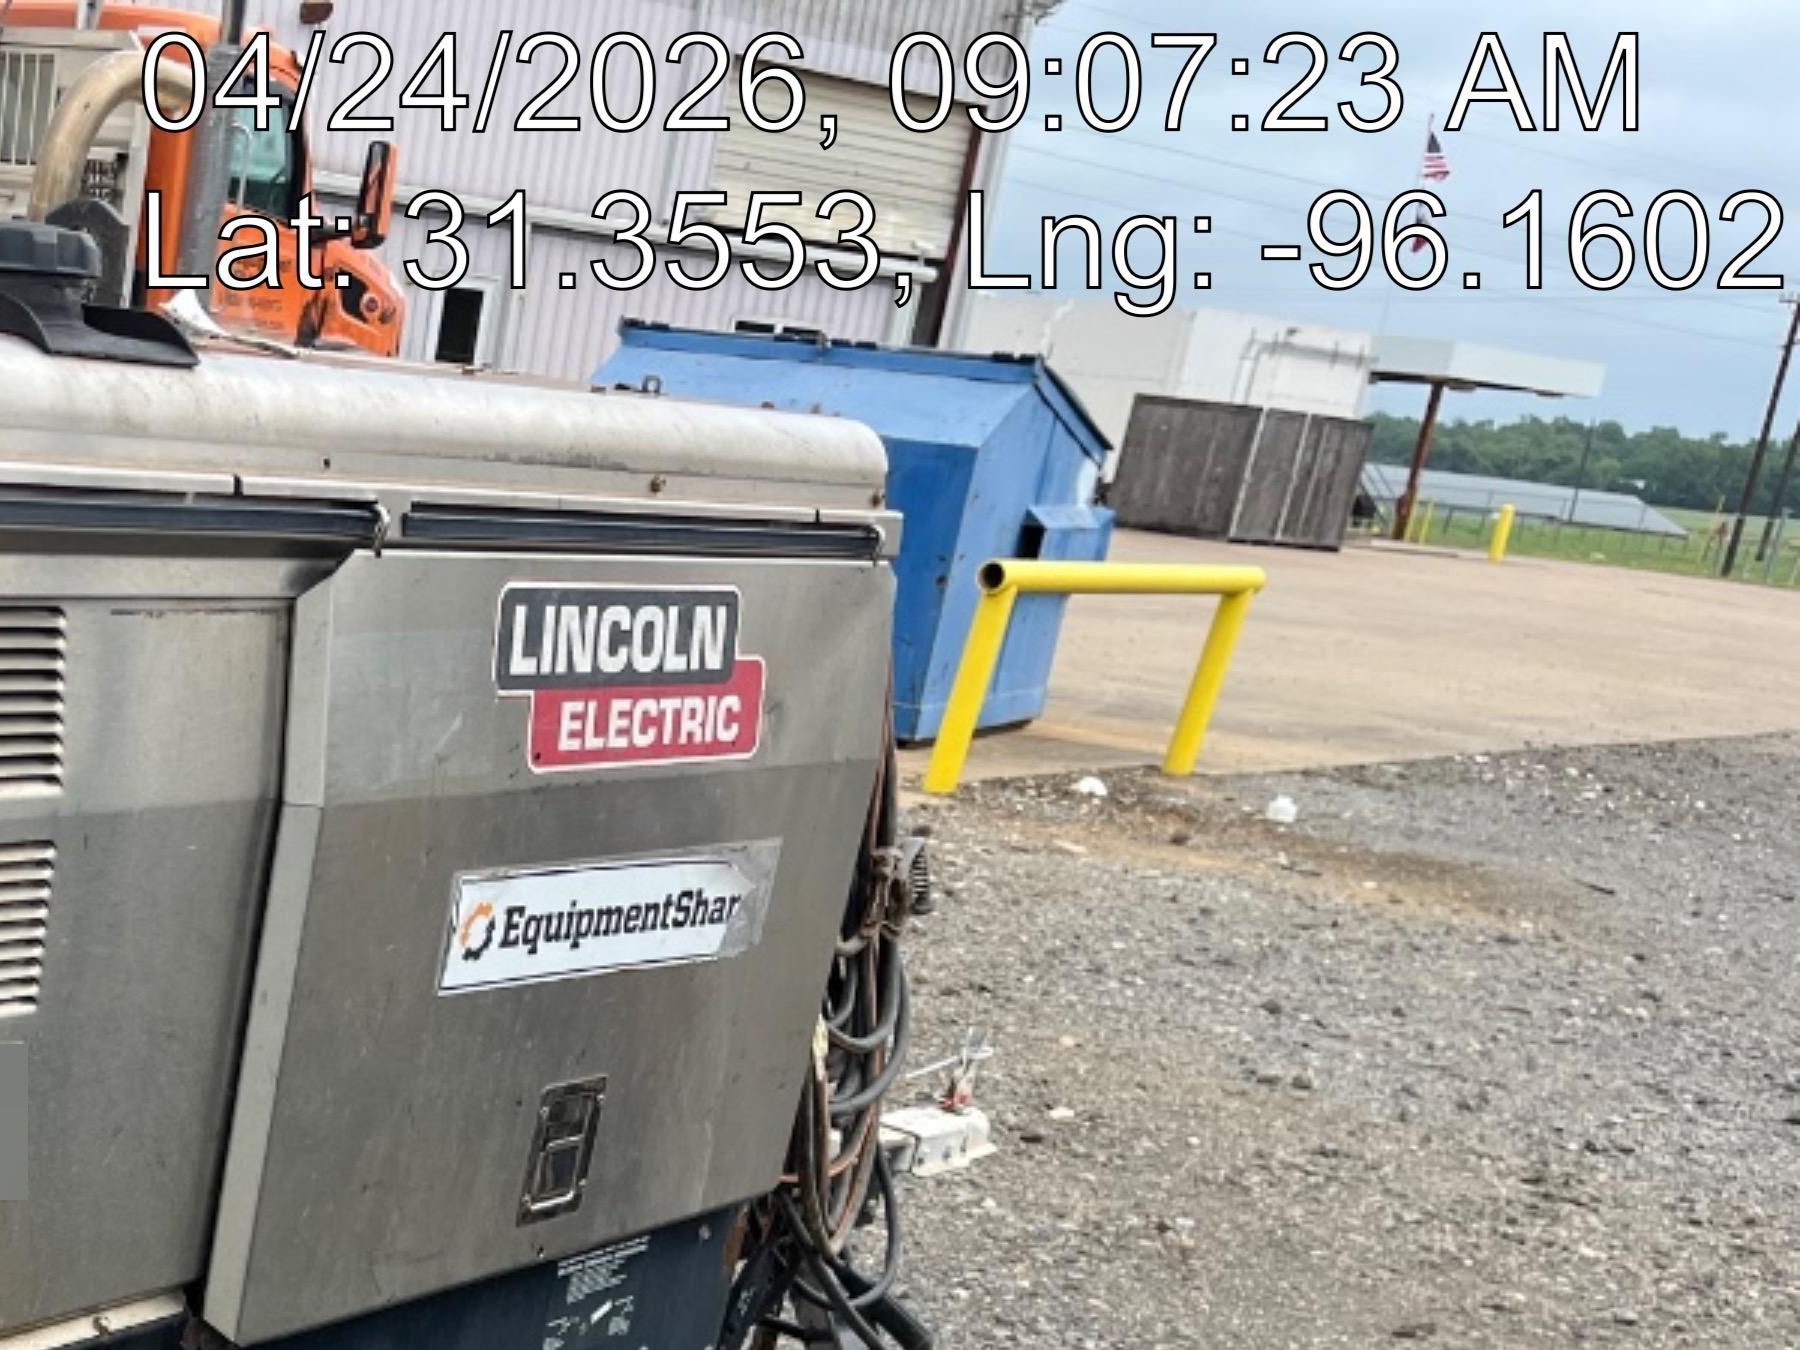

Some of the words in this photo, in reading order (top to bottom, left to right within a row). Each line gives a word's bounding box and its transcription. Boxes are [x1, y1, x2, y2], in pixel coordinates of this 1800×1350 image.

[508, 604, 728, 677] LINCOLN
[557, 694, 742, 752] ELECTRIC
[498, 888, 742, 956] EquipmentShar
